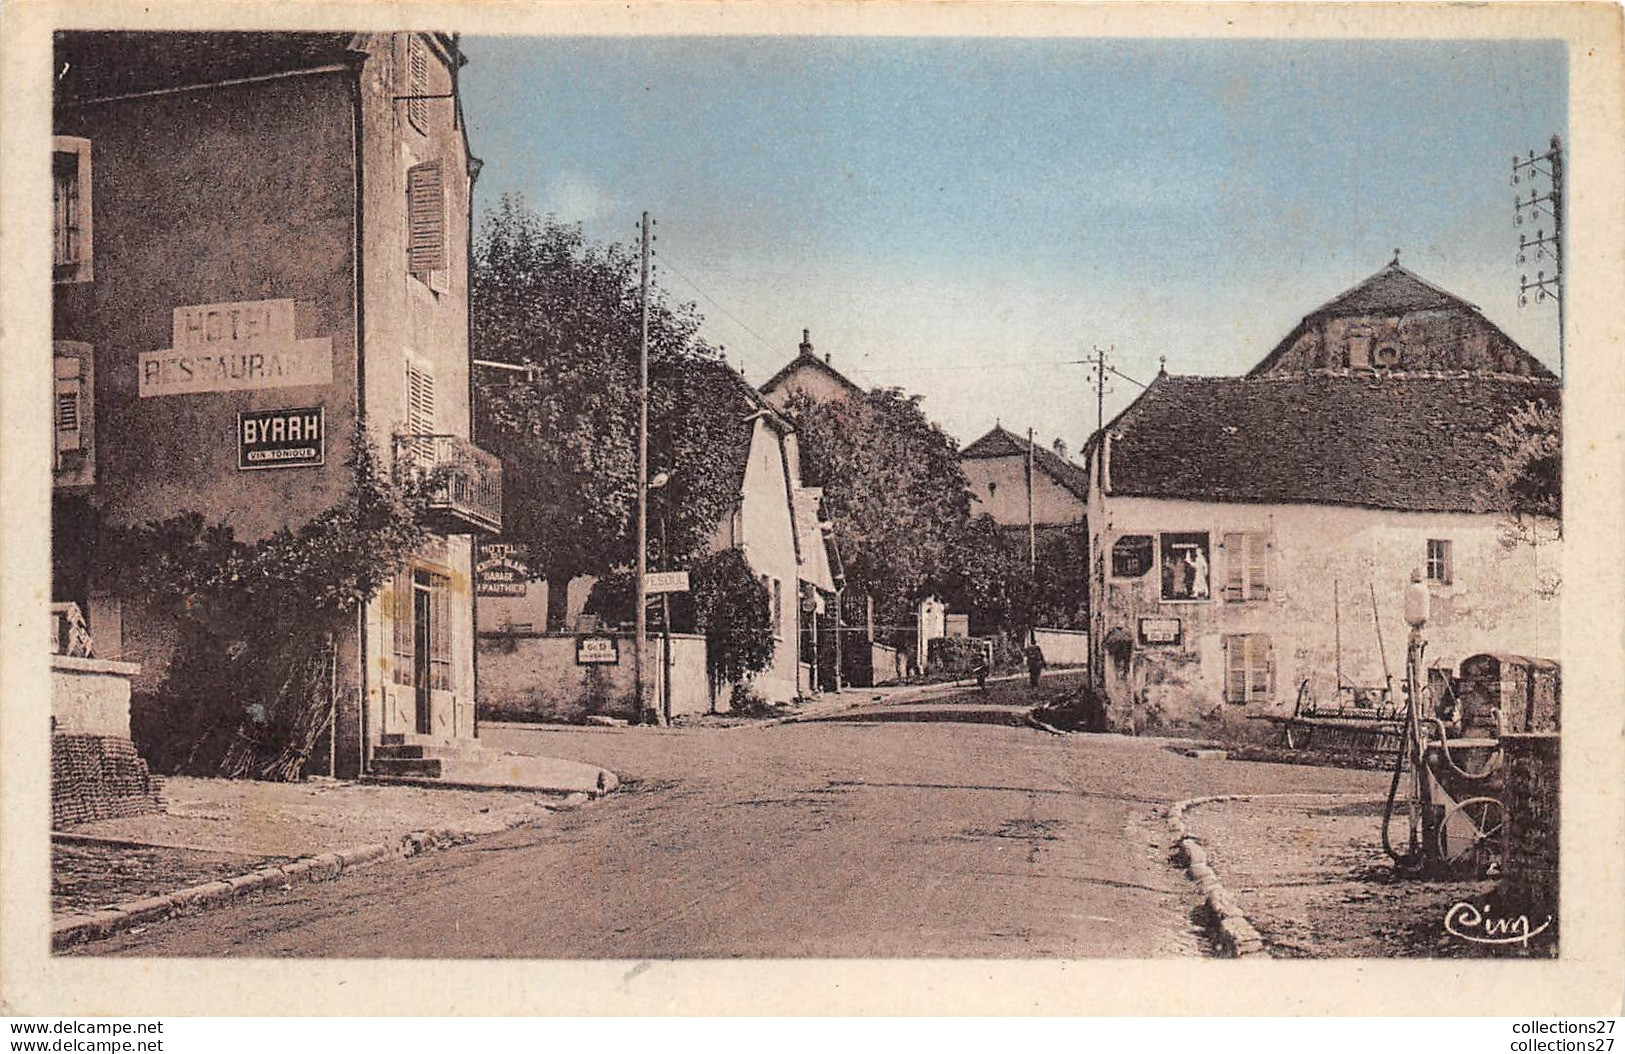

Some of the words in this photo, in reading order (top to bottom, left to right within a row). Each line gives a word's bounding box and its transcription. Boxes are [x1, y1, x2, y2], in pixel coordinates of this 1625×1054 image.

[243, 415, 319, 444] BYRRH
[250, 452, 266, 460] VIN
[271, 449, 312, 459] TONIQUE
